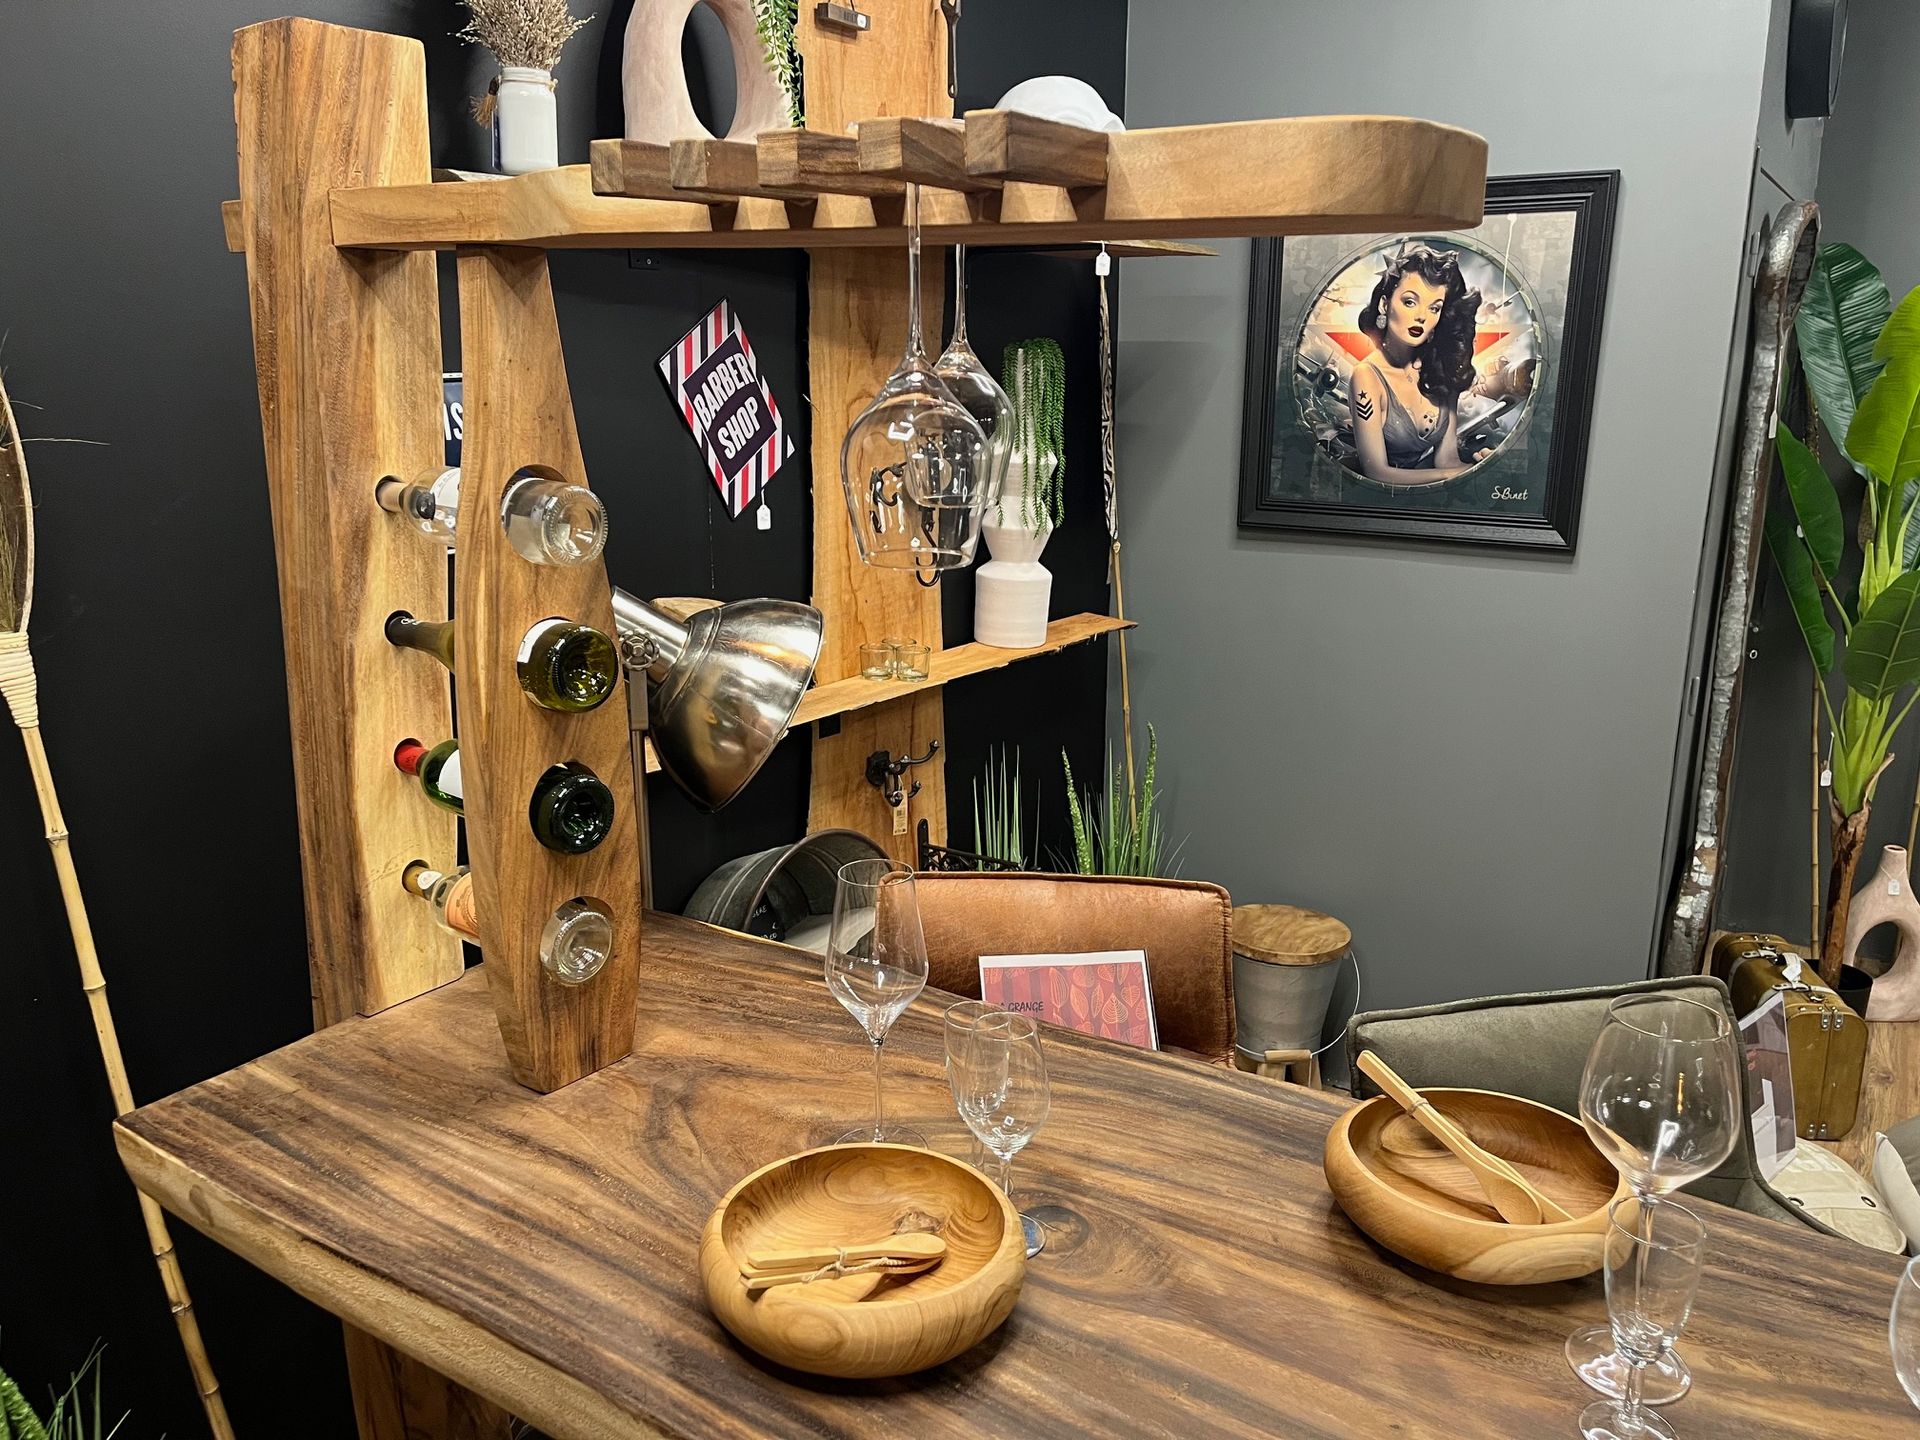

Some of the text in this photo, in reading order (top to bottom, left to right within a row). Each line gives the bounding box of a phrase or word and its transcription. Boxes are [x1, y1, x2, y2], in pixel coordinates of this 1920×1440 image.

[693, 353, 755, 432] BARBER
[717, 397, 760, 460] SHOP
[1008, 1001, 1044, 1012] GRANGE
